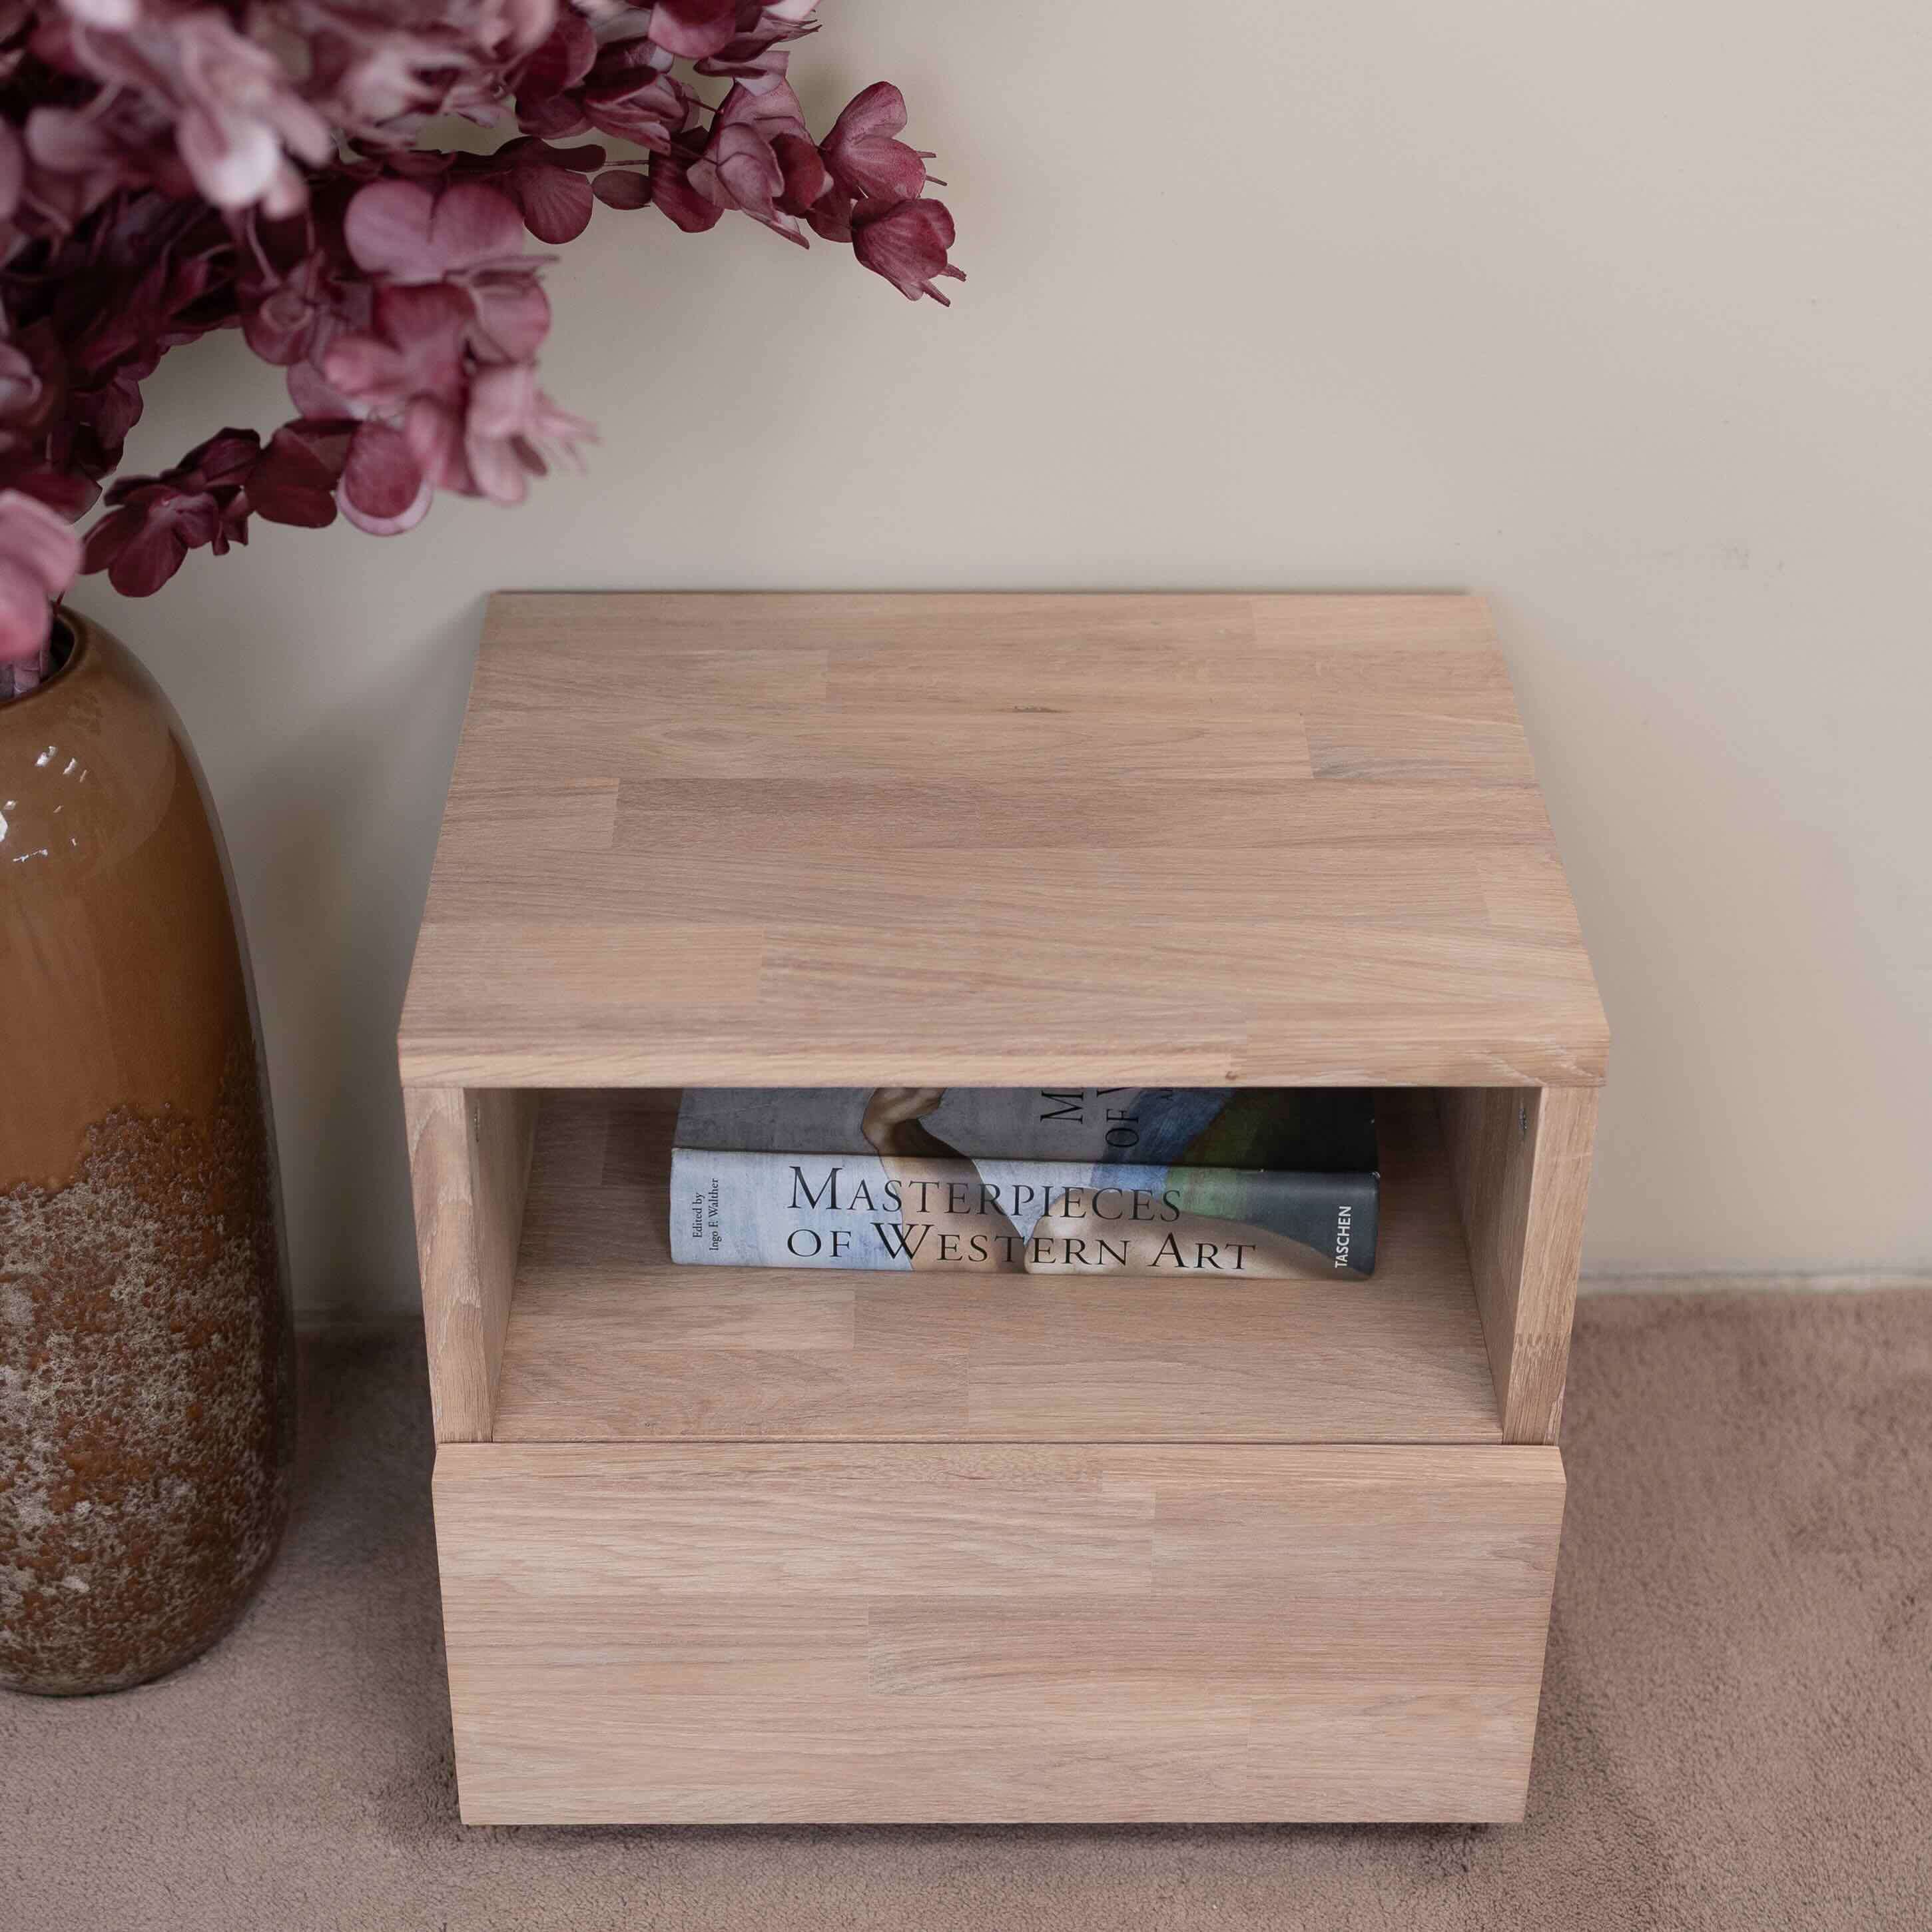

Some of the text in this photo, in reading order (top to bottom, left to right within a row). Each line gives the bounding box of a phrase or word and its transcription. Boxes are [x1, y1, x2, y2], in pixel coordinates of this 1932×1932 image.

[1105, 1109, 1139, 1147] OF
[692, 1192, 705, 1238] Edited by
[708, 1177, 719, 1218] Walther
[787, 1165, 1181, 1223] MASTERPIECES
[709, 1231, 722, 1251] Ingo
[787, 1221, 1257, 1271] OF WESTERN ART
[1334, 1205, 1353, 1269] TASCHEN
